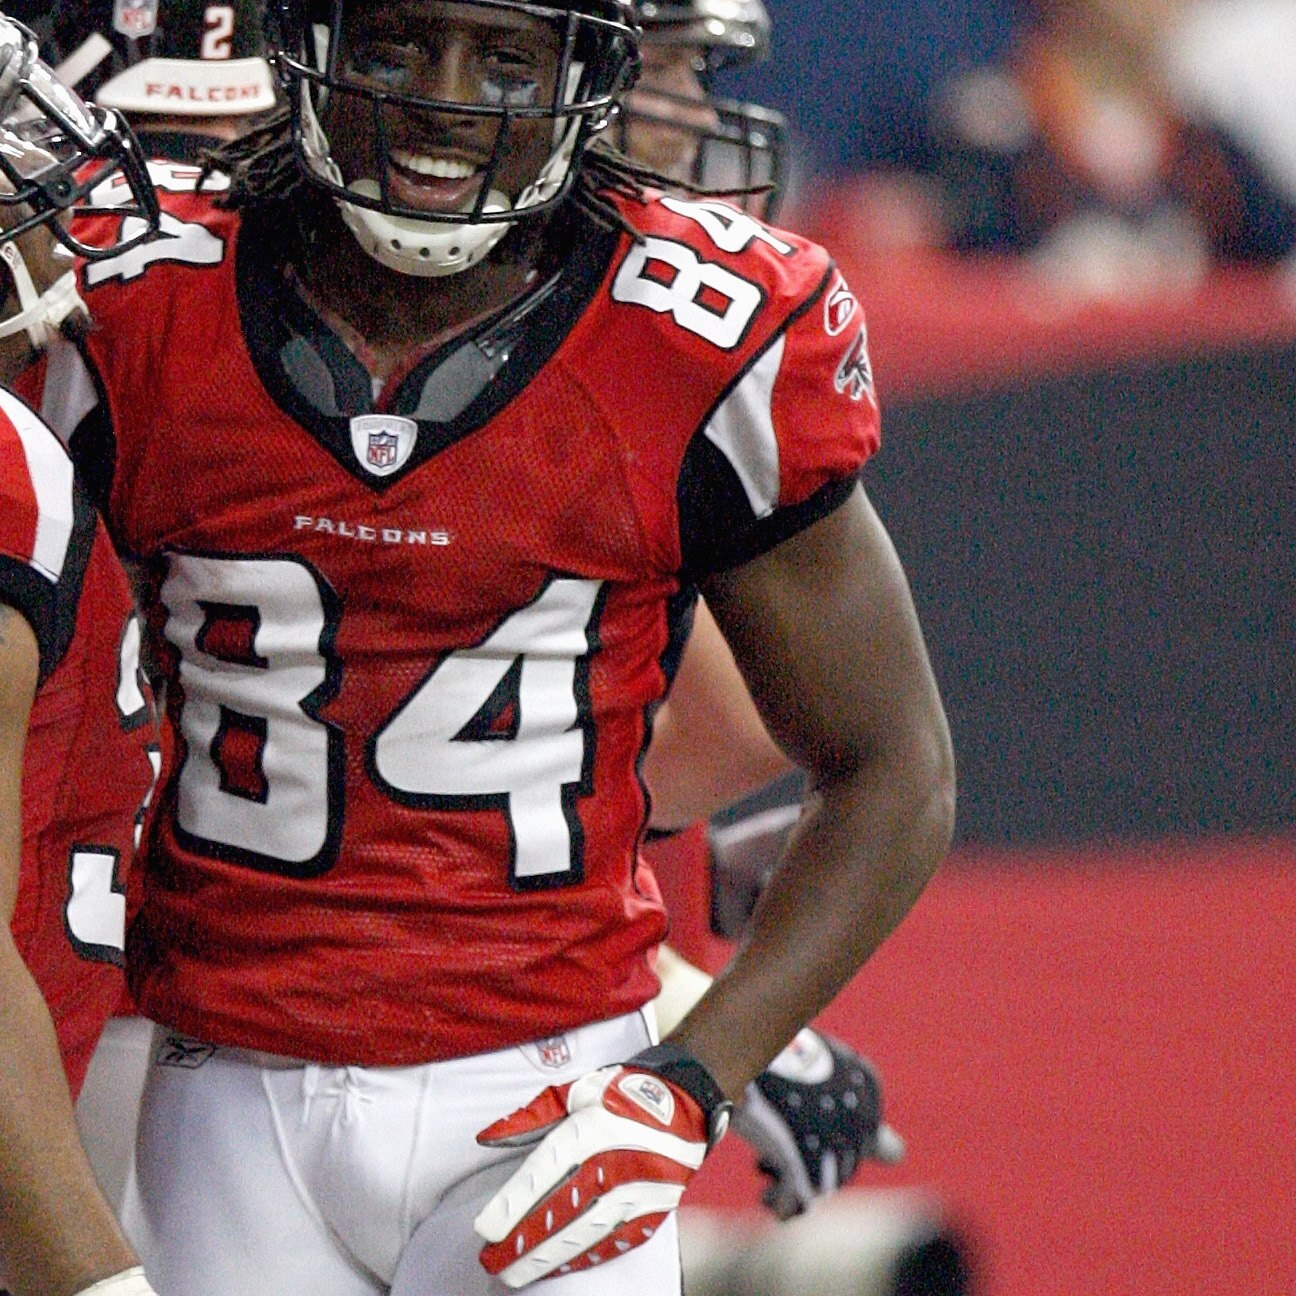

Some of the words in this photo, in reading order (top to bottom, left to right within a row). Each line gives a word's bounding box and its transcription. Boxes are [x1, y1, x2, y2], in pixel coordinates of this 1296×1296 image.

[201, 4, 235, 60] 2
[610, 196, 800, 352] 84
[292, 514, 451, 546] FALCONS
[157, 550, 609, 888] 84
